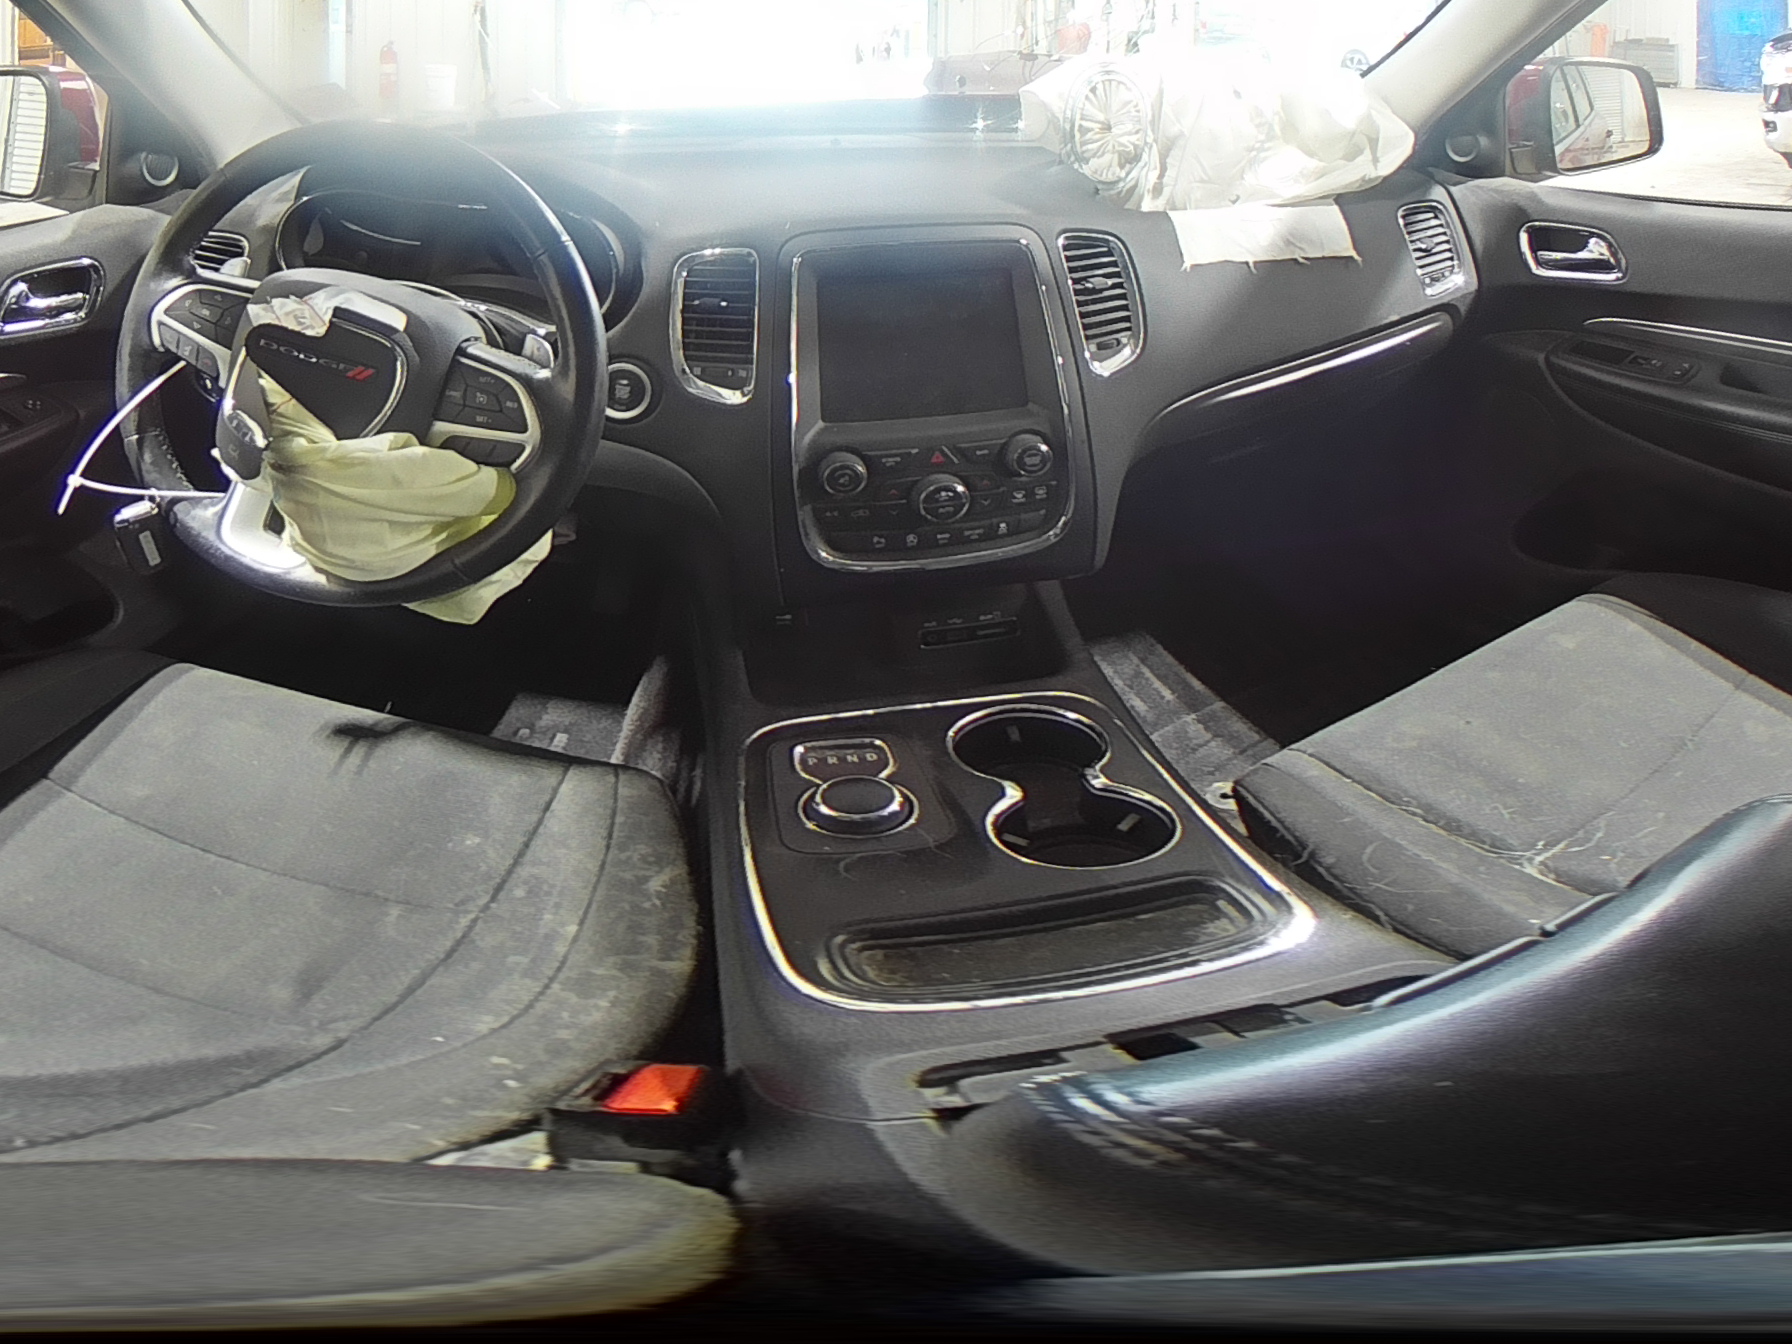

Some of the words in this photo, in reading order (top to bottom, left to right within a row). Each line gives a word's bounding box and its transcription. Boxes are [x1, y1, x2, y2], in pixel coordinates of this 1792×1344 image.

[808, 757, 818, 766] P
[827, 756, 839, 764] R
[846, 754, 859, 763] N
[866, 753, 878, 761] D
